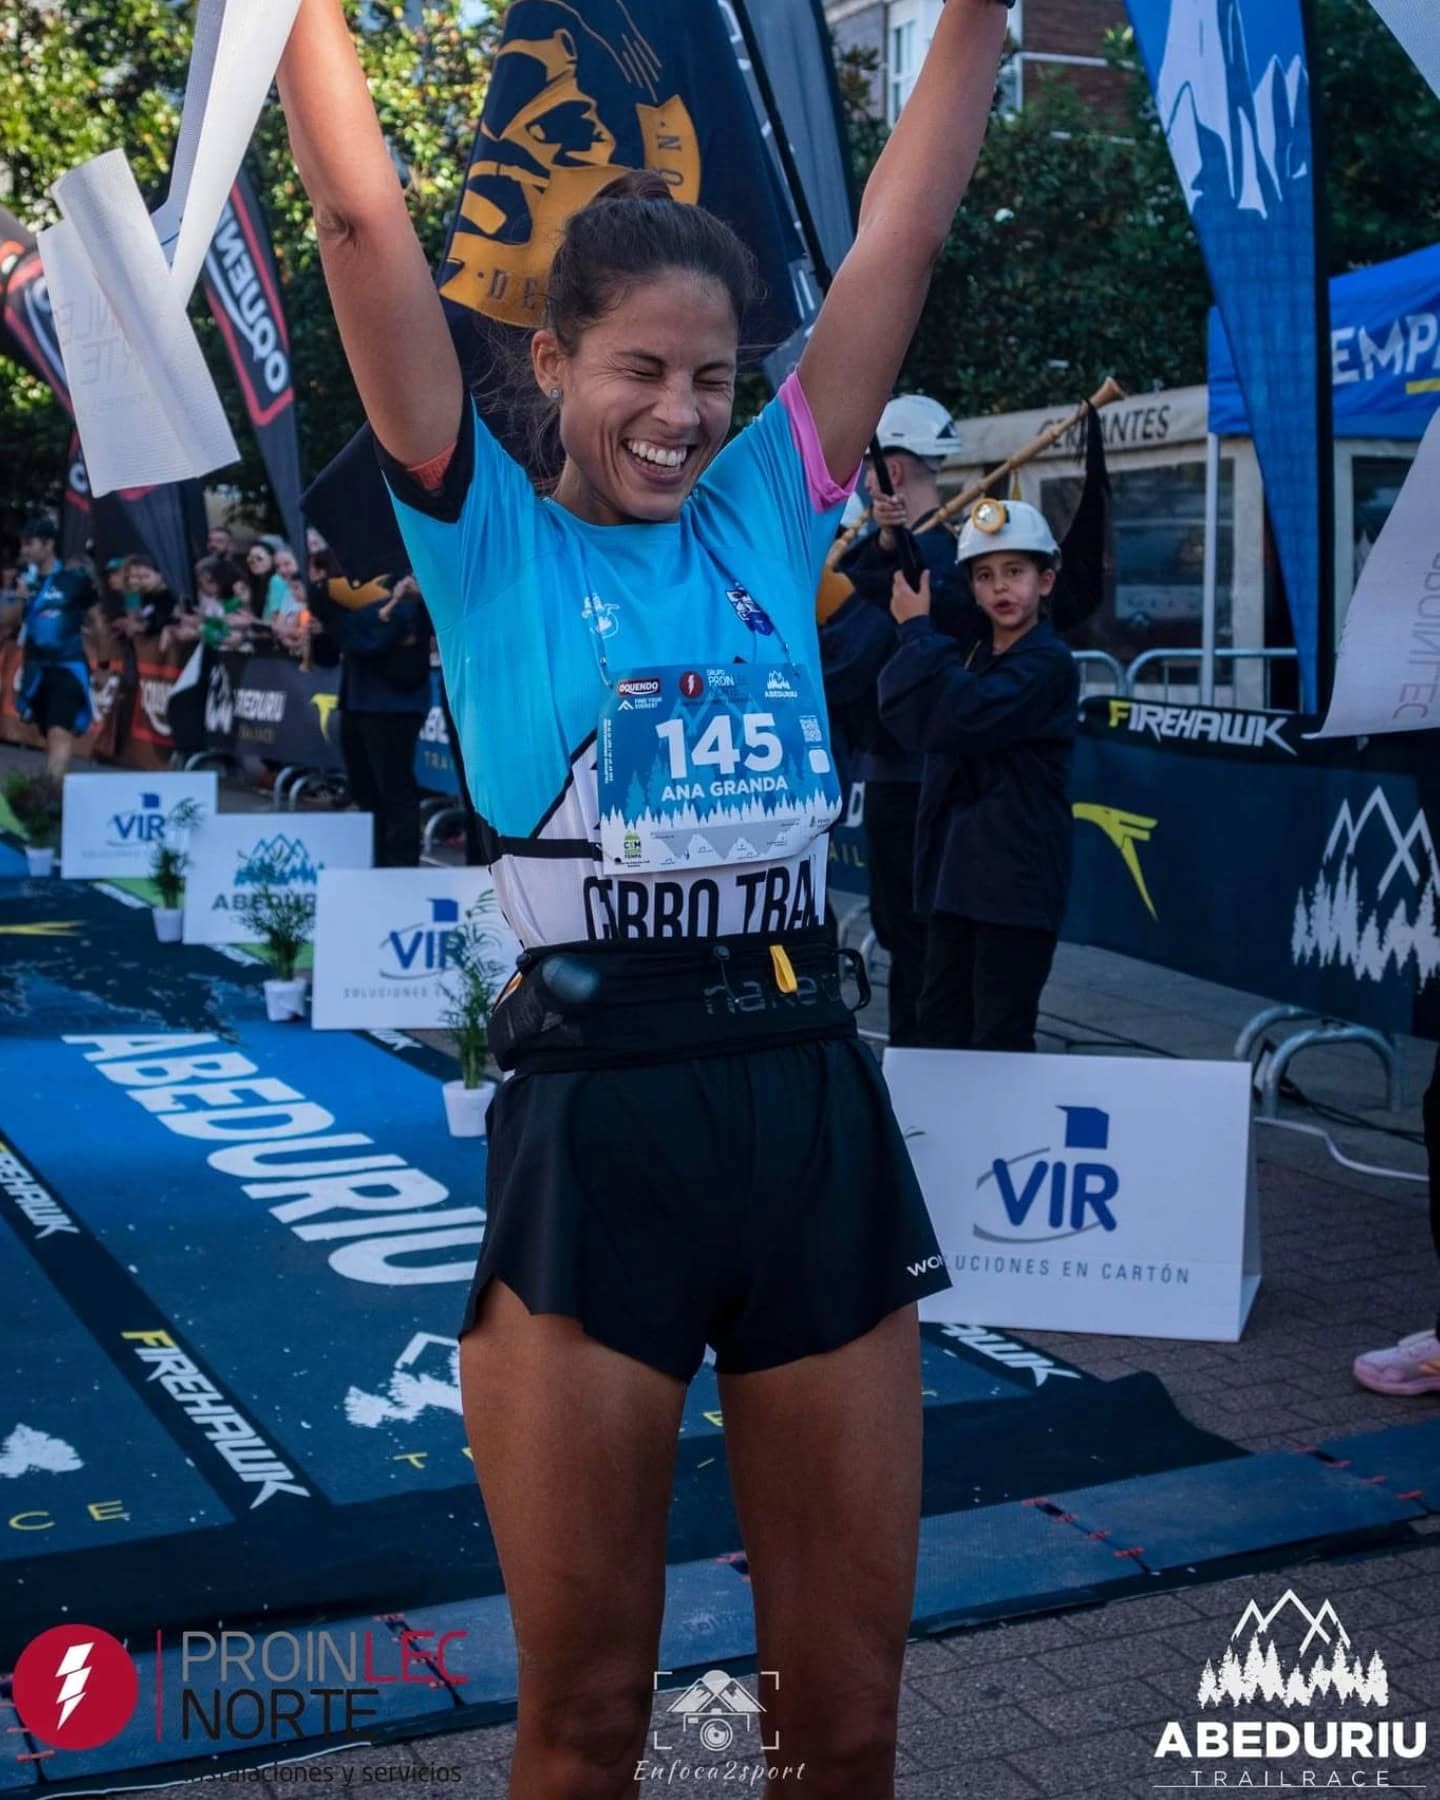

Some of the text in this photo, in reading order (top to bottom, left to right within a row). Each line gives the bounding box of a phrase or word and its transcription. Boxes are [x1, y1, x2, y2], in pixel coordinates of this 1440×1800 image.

[1331, 312, 1440, 385] EMP
[655, 712, 783, 779] 145
[1108, 700, 1298, 756] FIREHAWK
[661, 777, 788, 802] ANA GRANDA
[113, 814, 165, 841] VIR
[389, 930, 467, 970] VIR
[62, 1035, 488, 1286] ABEDURIU
[993, 1158, 1119, 1231] VIR
[906, 1253, 944, 1277] WO
[952, 1255, 1190, 1285] UCIONES EN CARTÓN
[121, 1329, 311, 1510] FIREHAWK
